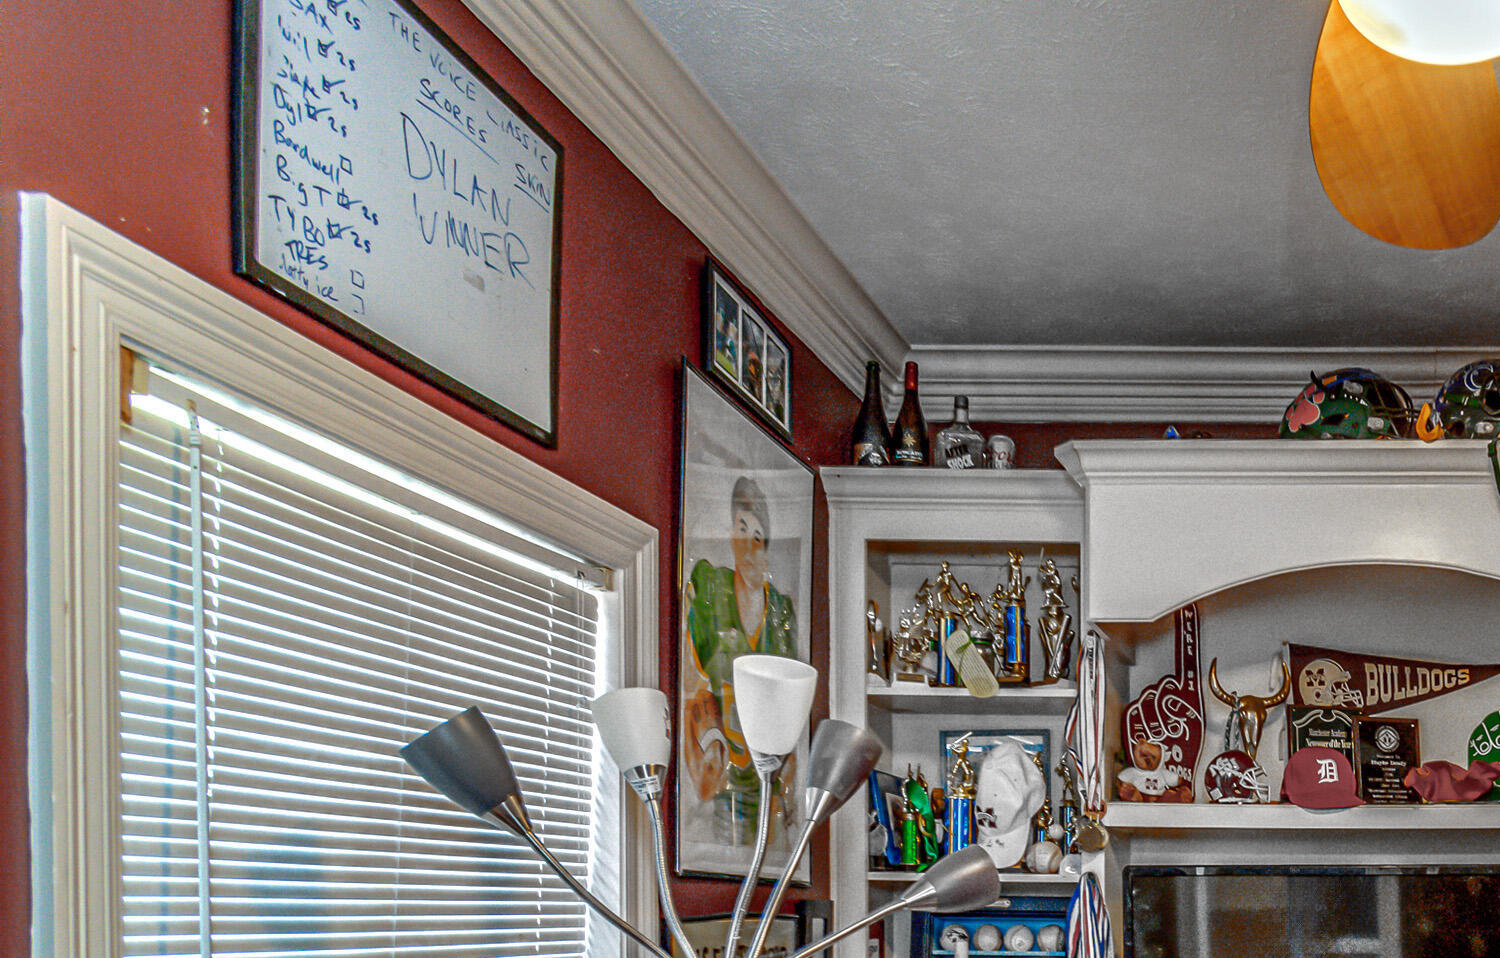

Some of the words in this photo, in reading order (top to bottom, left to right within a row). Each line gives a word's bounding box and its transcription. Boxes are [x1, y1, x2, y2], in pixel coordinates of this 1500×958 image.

[387, 12, 422, 53] THE
[419, 78, 488, 144] SCORES
[400, 112, 511, 227] DYLAN
[1363, 662, 1471, 706] BULLDOGS
[1315, 757, 1340, 784] D
